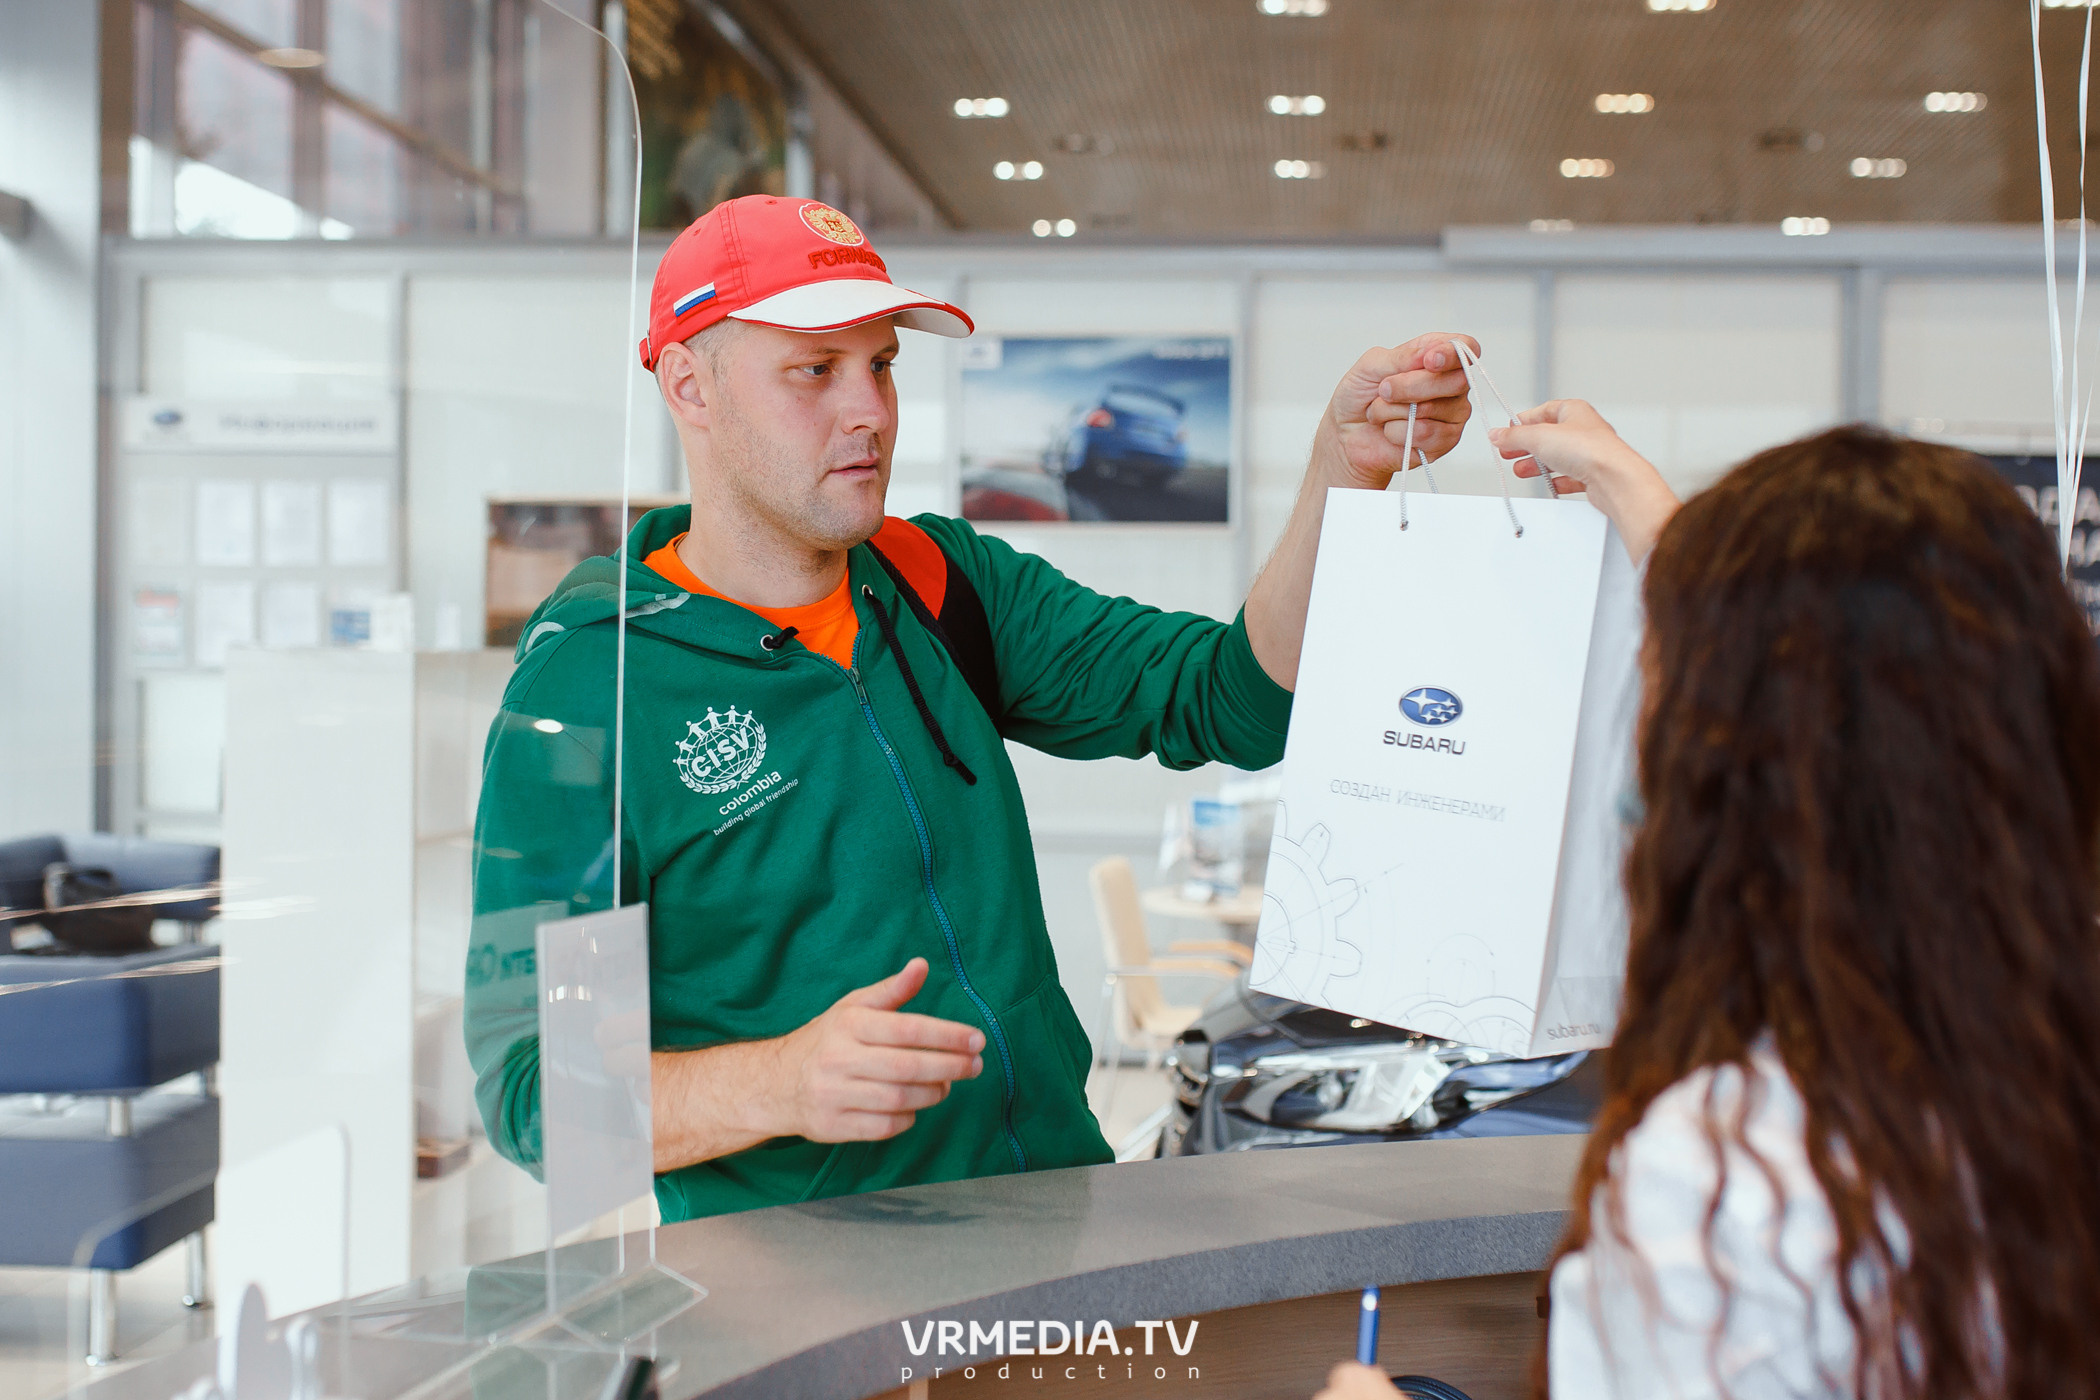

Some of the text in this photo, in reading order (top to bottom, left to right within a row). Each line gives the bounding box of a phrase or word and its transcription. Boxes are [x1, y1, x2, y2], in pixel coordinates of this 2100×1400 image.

[691, 727, 750, 777] CISV
[1383, 730, 1466, 755] SUBARU
[713, 778, 799, 836] building global friendship
[719, 771, 782, 815] colombia
[1330, 779, 1506, 822] СОЗДАН ИНЖЕНЕРАМИ
